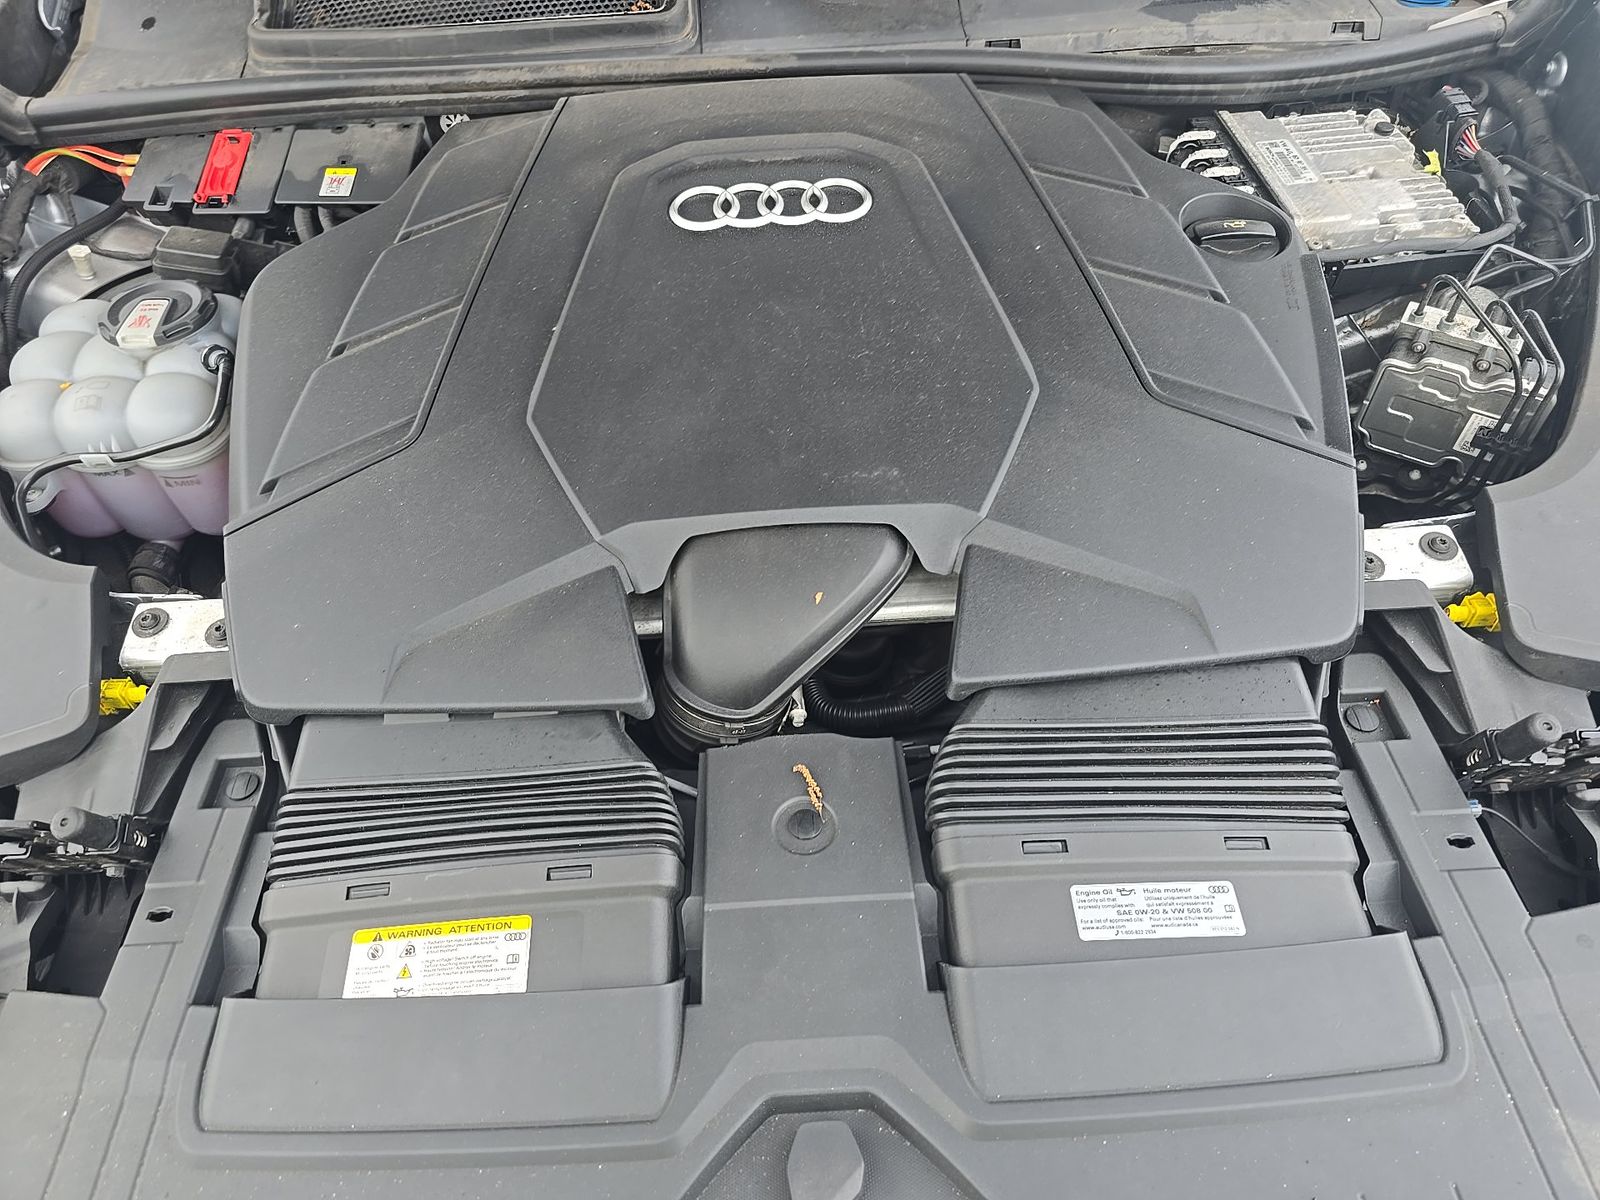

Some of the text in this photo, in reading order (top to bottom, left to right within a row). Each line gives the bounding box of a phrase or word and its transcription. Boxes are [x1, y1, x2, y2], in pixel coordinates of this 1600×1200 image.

[1075, 888, 1101, 897] Engine
[387, 921, 512, 940] WARNING ATTENTION
